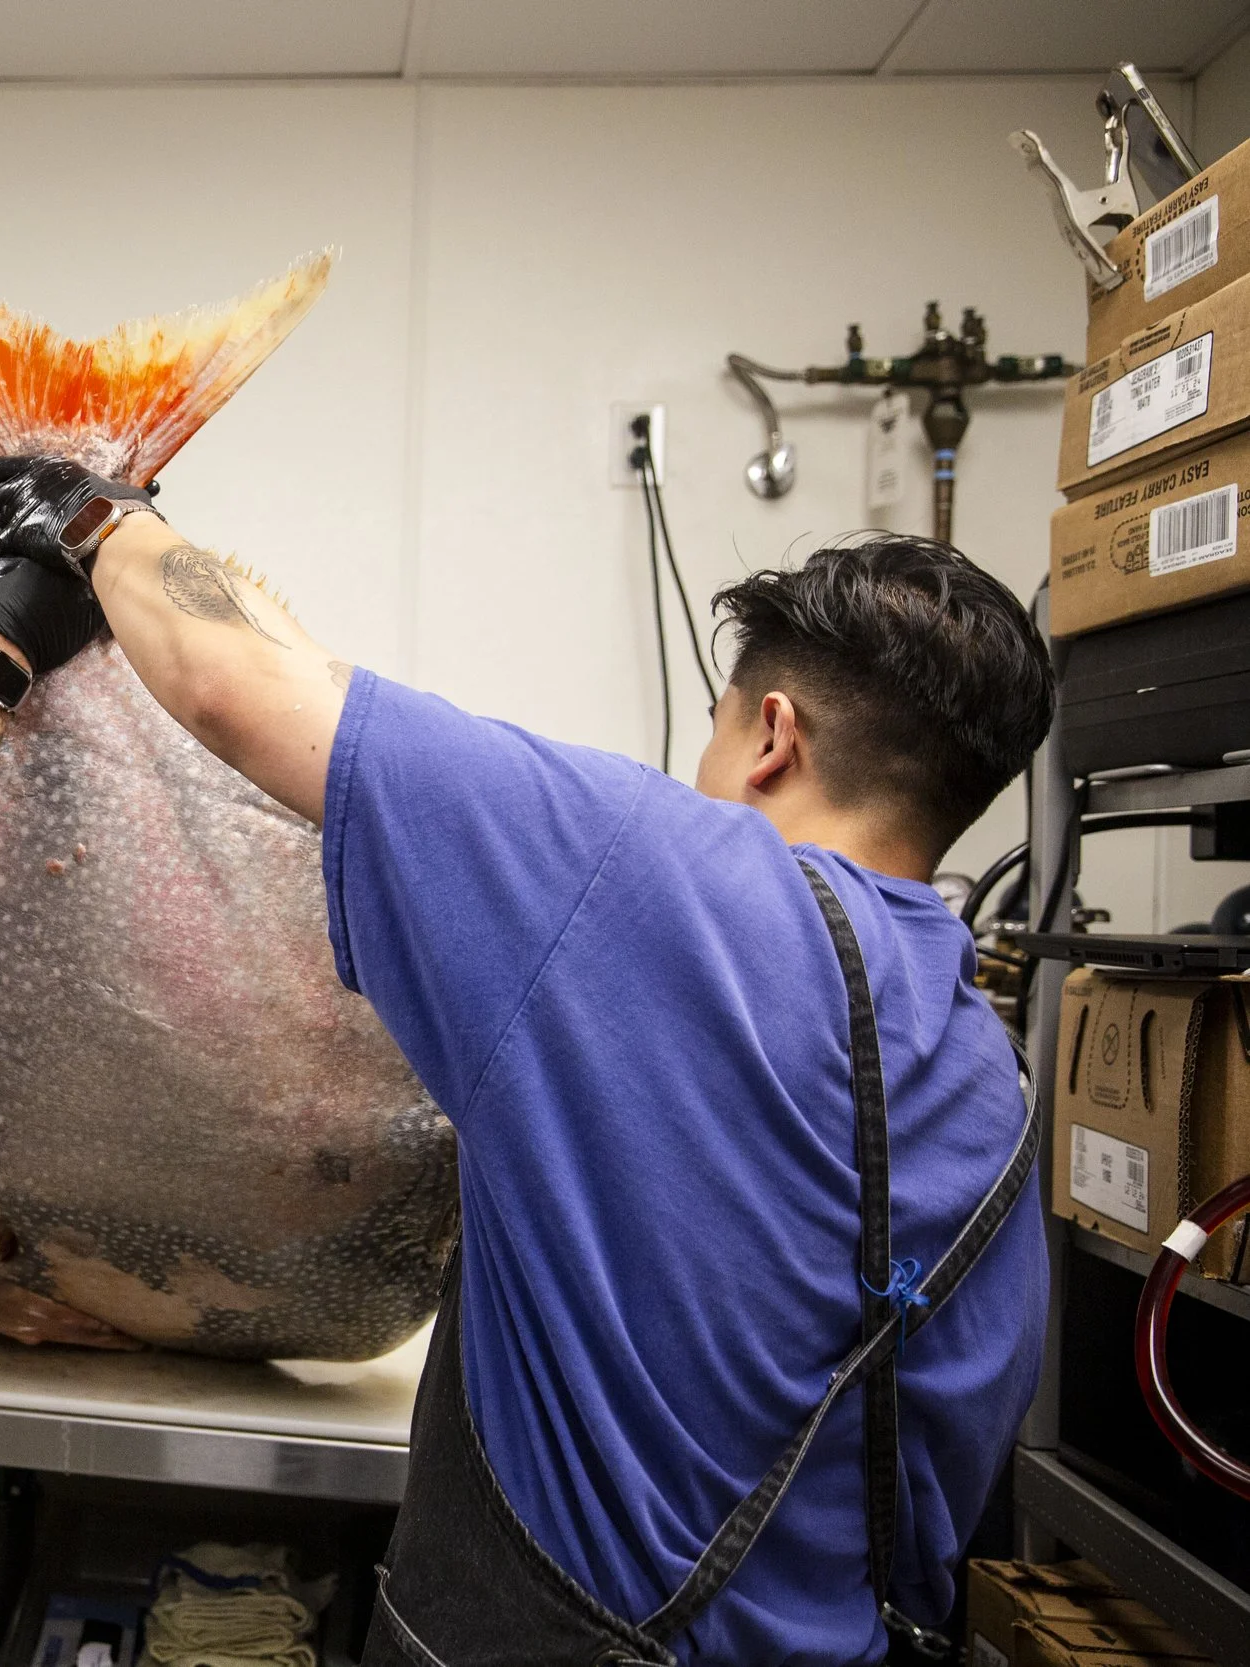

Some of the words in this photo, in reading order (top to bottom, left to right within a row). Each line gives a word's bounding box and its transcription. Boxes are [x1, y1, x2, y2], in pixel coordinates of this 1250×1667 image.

[1188, 177, 1209, 200] EASY
[1164, 192, 1187, 215] CARRY
[1132, 209, 1162, 238] FEATURE
[1141, 473, 1177, 502] CARRY
[1179, 460, 1209, 487] EASY
[1094, 489, 1139, 520] FEATURE
